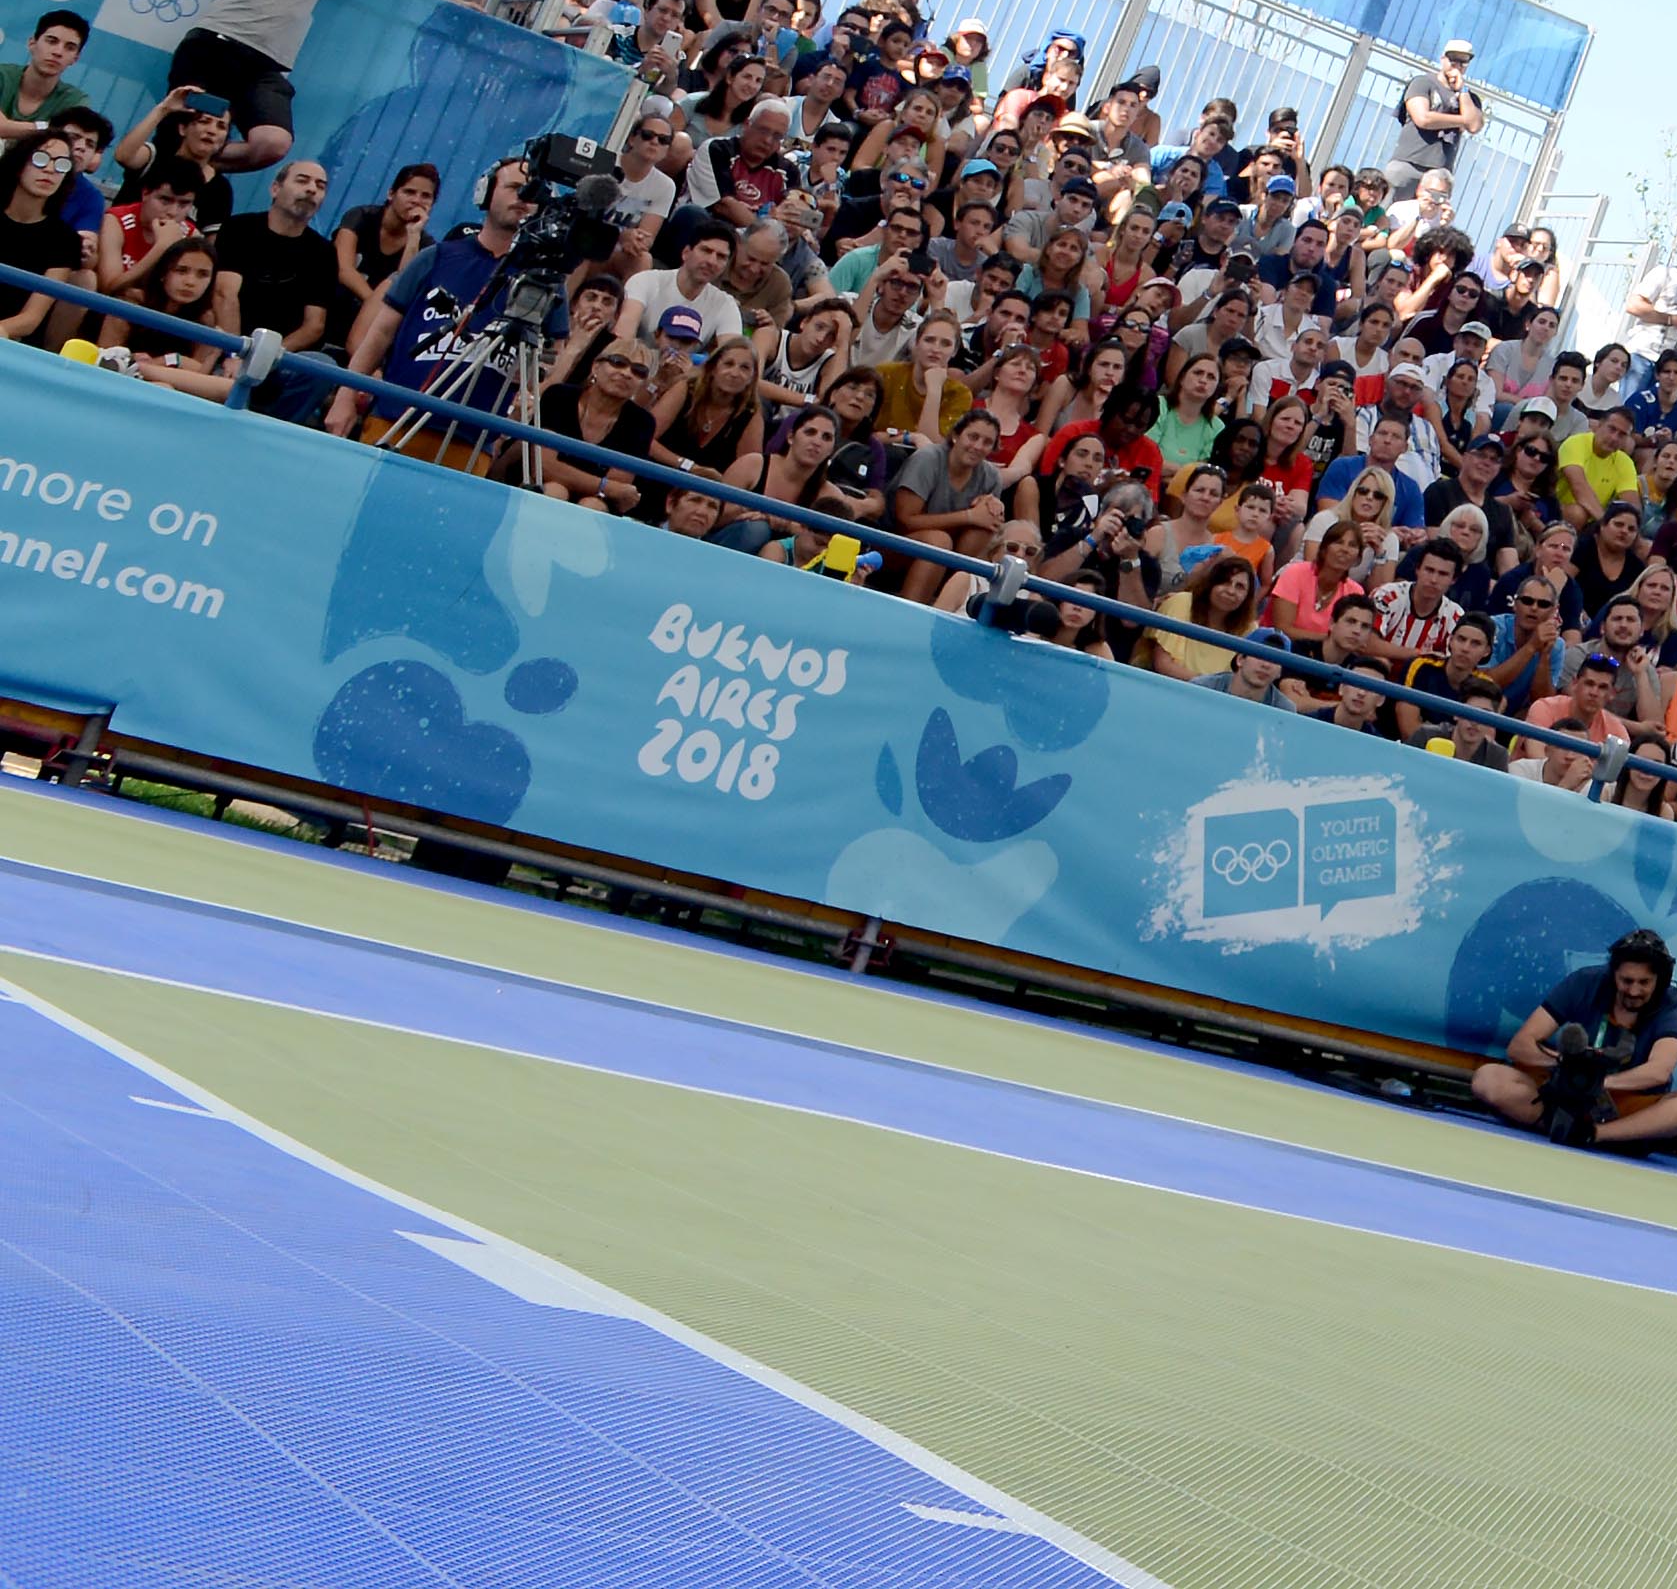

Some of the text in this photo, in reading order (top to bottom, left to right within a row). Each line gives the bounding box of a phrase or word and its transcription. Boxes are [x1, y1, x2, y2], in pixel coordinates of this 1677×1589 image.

[582, 142, 592, 153] 5
[148, 503, 218, 547] on
[648, 603, 849, 695] BUENOS
[656, 664, 806, 741] AIRES
[637, 718, 780, 801] 2018
[1320, 815, 1380, 837] YOUTH
[1311, 838, 1389, 862] OLYMPIC
[1319, 863, 1382, 885] GAMES
